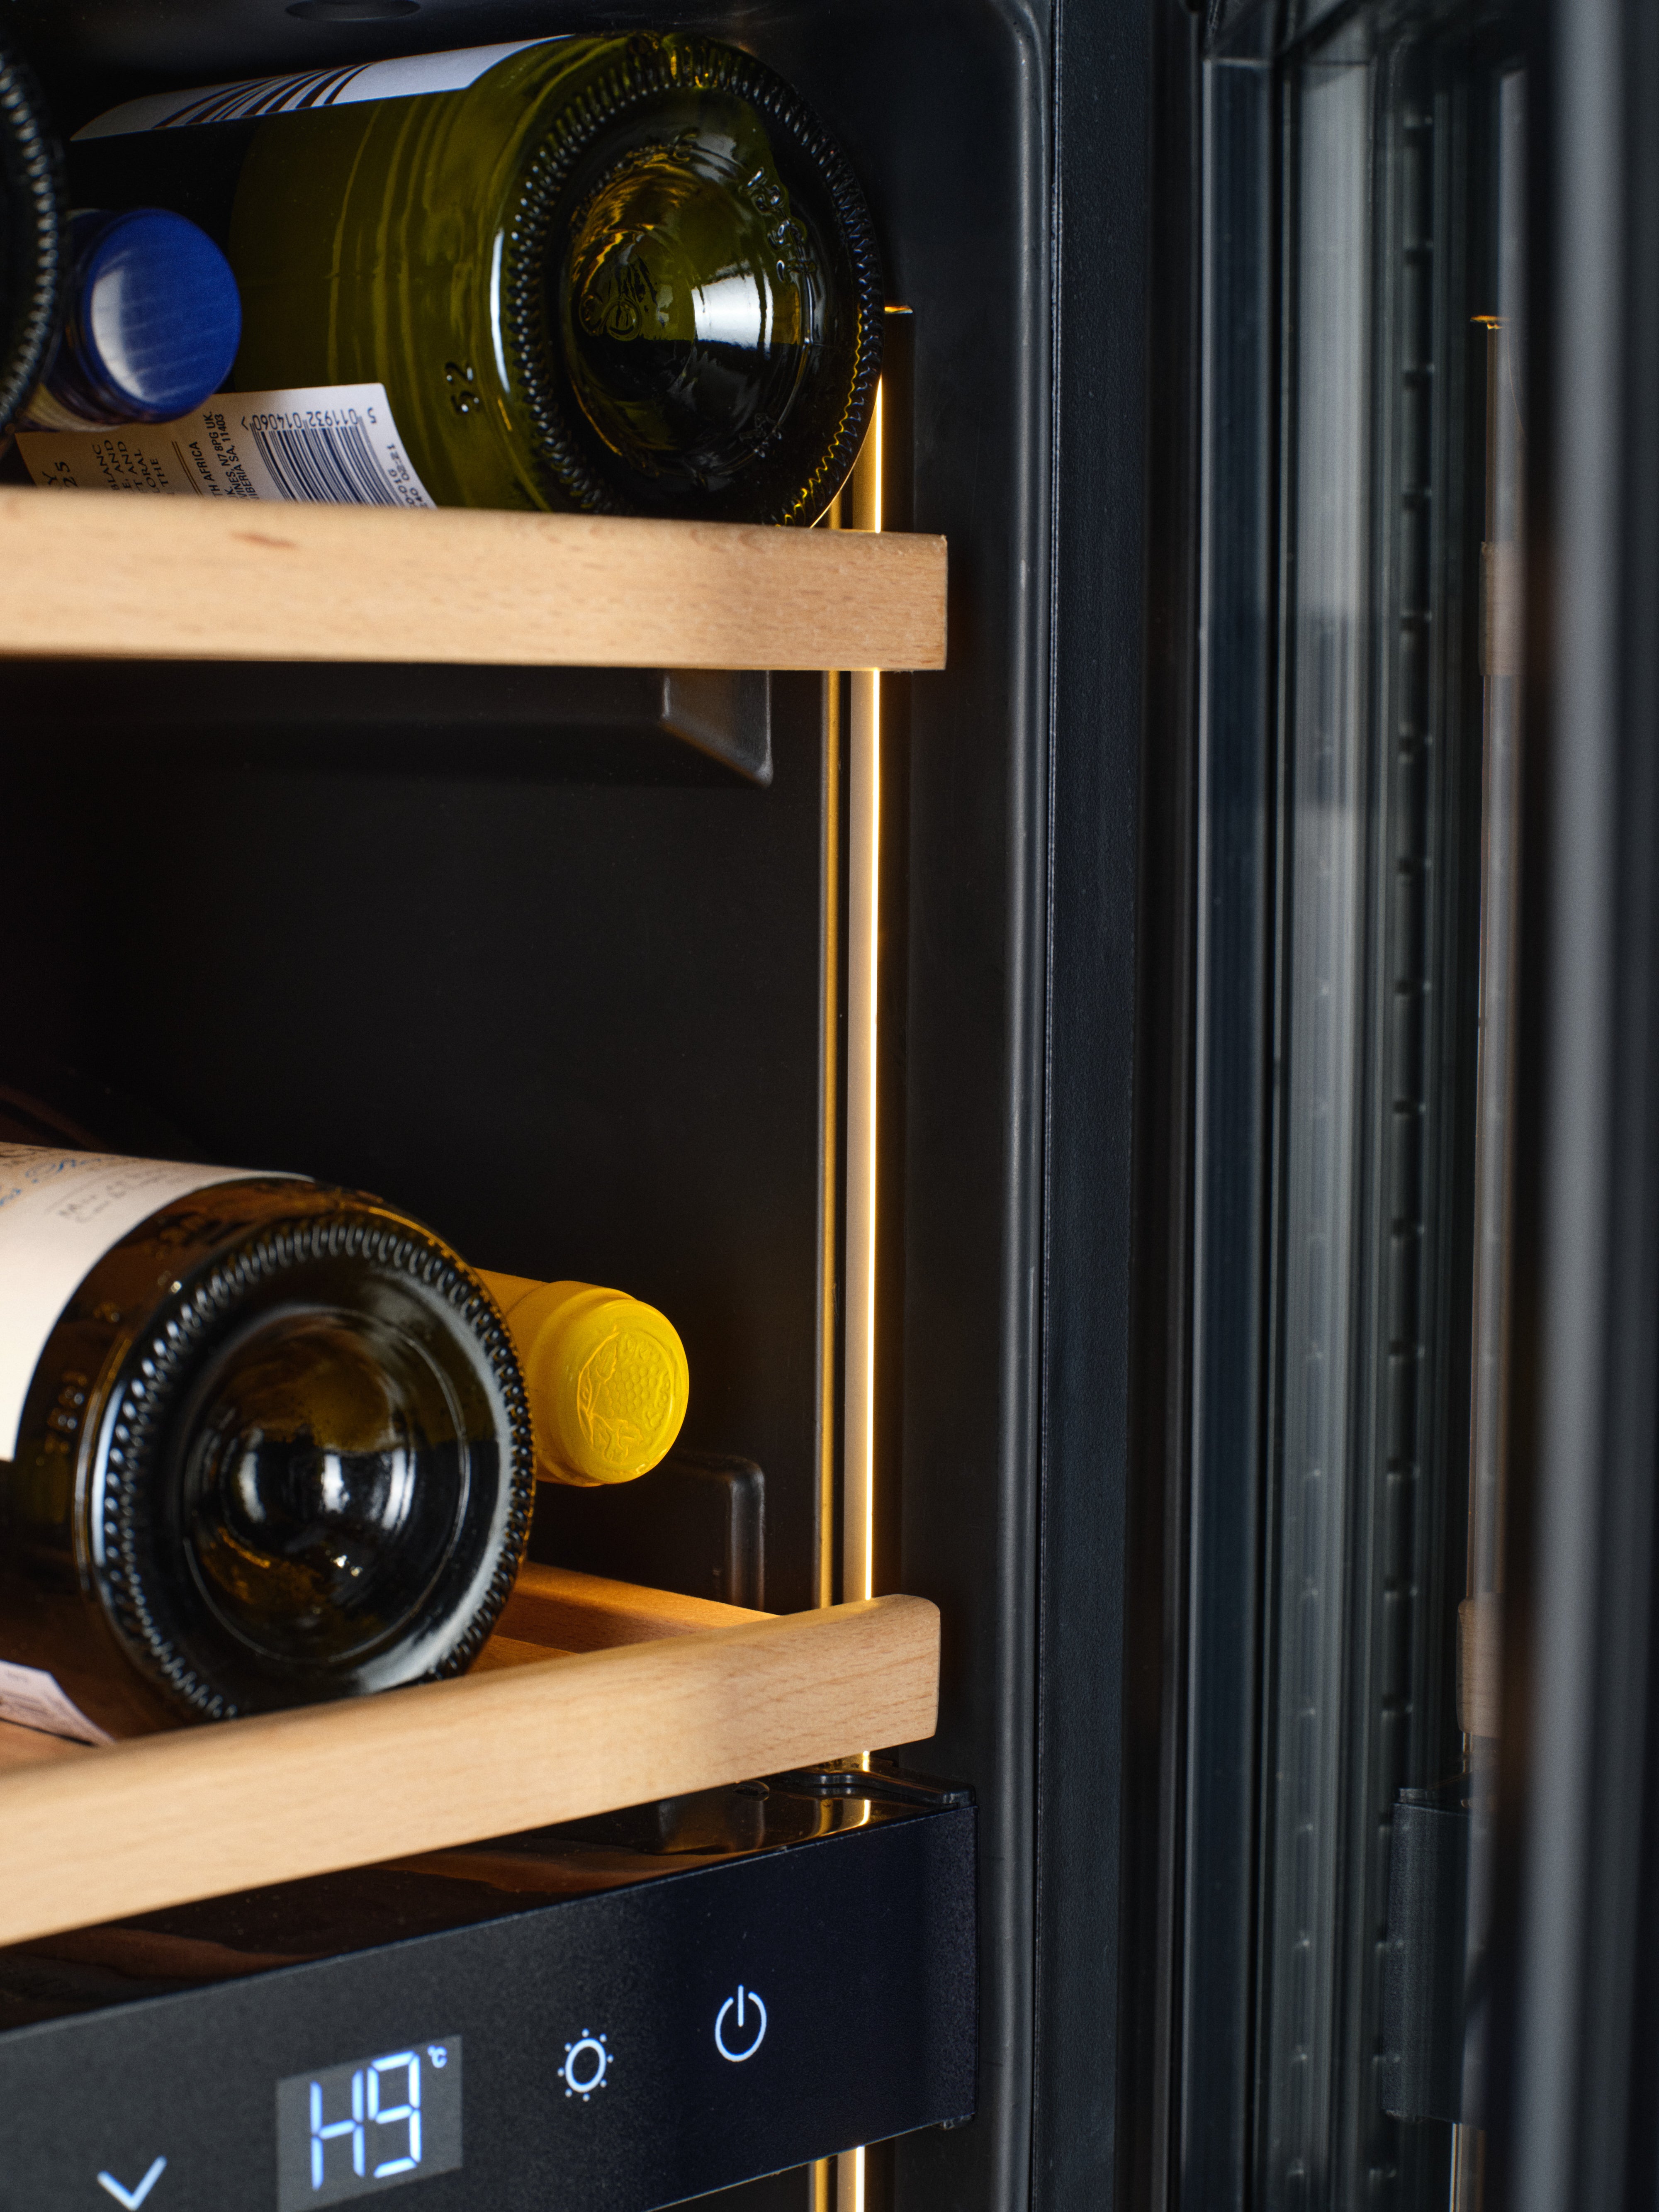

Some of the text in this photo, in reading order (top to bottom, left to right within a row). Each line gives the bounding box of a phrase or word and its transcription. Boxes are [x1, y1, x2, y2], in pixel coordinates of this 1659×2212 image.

[202, 411, 216, 429] UK.
[214, 414, 231, 442] 11403
[252, 407, 377, 431] 5 011932 014060
[209, 431, 224, 452] 8PG
[226, 445, 239, 462] SA,
[91, 444, 120, 491] BLANC
[104, 440, 124, 474] AND
[117, 441, 138, 475] AND
[188, 441, 216, 482] AFRICA
[217, 453, 231, 466] N7
[54, 461, 78, 488] 25
[150, 458, 169, 487] THE
[310, 2050, 422, 2192] H9
